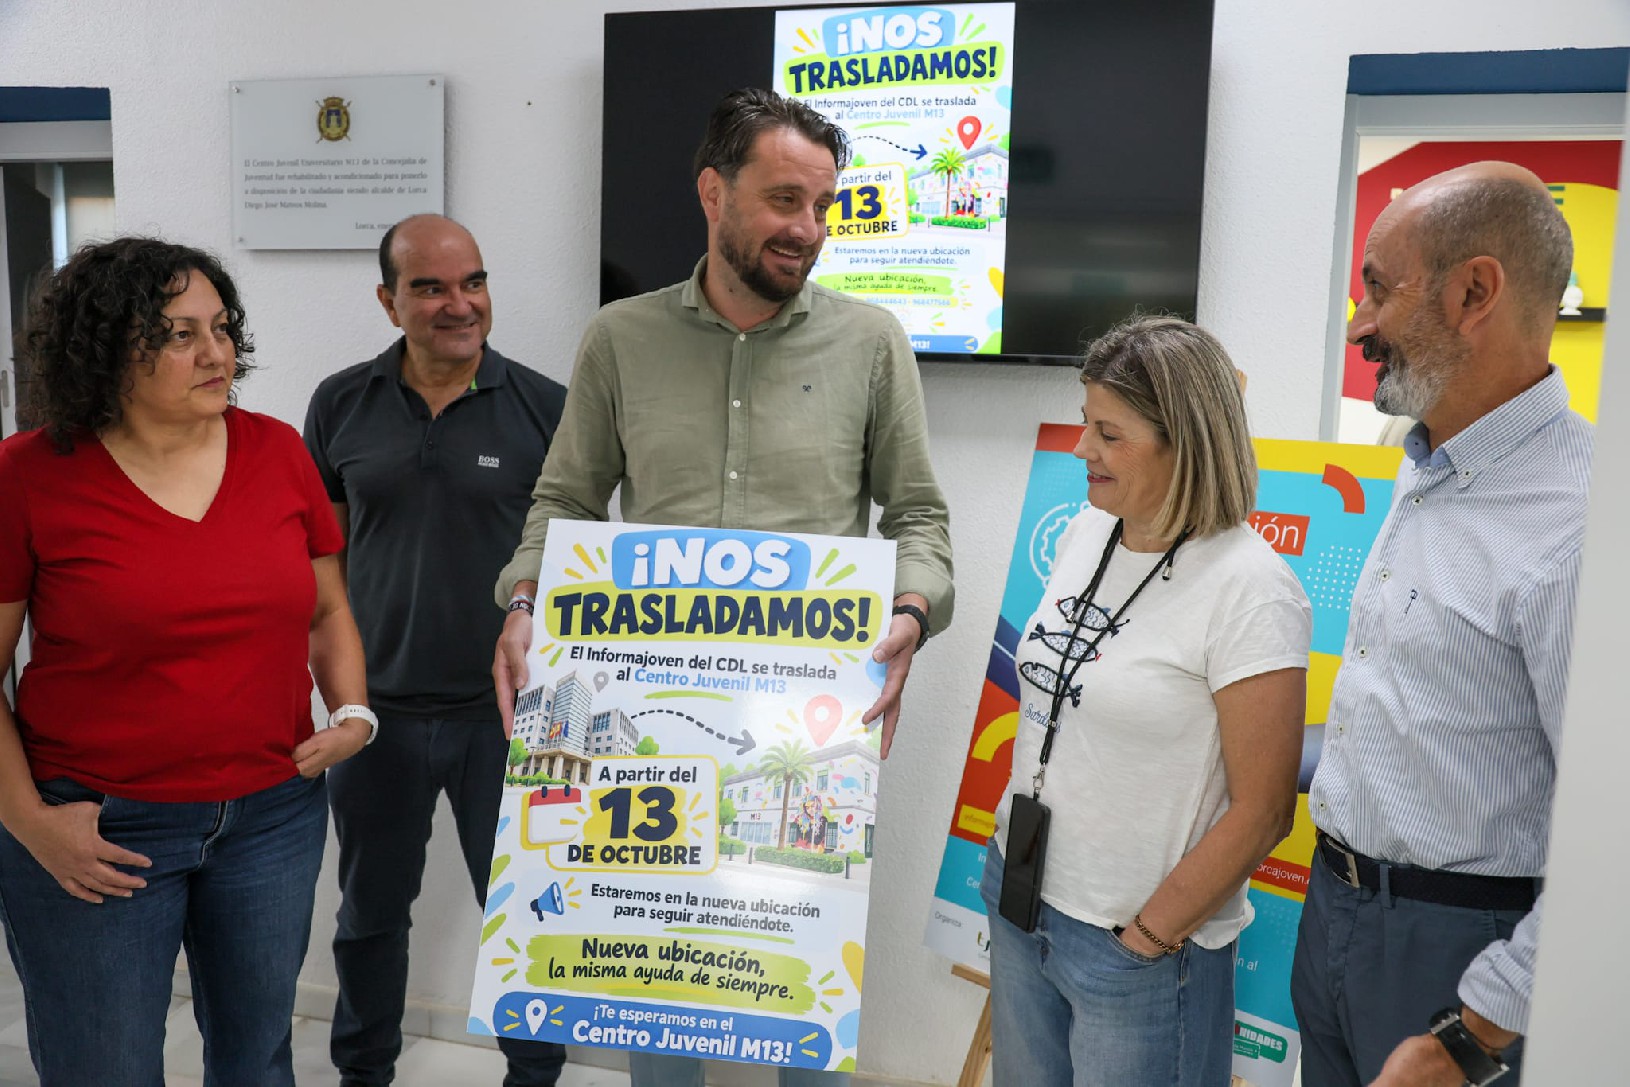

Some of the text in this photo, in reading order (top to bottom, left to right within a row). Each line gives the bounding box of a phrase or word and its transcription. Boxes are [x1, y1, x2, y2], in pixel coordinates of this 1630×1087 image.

[836, 11, 943, 55] ¡NOS
[789, 46, 998, 93] TRASLADAMOS!
[815, 98, 877, 110] Informajoven
[880, 97, 895, 106] del
[898, 97, 918, 106] CDL
[921, 98, 933, 106] se
[935, 96, 977, 106] traslada
[835, 108, 945, 120] al Centro Juvenil M13
[842, 171, 892, 186] partir del
[835, 185, 882, 220] 13
[837, 220, 898, 236] OCTUBRE
[834, 246, 970, 256] Estaremos en la nueva ubicación
[849, 257, 869, 265] para
[871, 256, 896, 266] seguir
[845, 274, 874, 283] Nueva
[478, 455, 500, 465] BOSS
[630, 538, 792, 589] ¡NOS
[553, 592, 872, 643] TRASLADAMOS!
[570, 645, 837, 680] El Informajoven del CDL se traslada
[616, 667, 787, 694] al Centro Juvenil M13
[599, 766, 697, 787] A partir del
[599, 785, 679, 842] 13
[567, 844, 702, 866] DE OCTUBRE
[590, 884, 820, 919] Estaremos en la nueva ubicación
[614, 903, 794, 933] para seguir atendiéndote.
[581, 938, 765, 977] Nueva ubicación,
[548, 957, 795, 1002] la misma ayuda de siempre.
[593, 1004, 733, 1031] ¡Te esperamos en el
[572, 1020, 793, 1064] Centro Juvenil M13!
